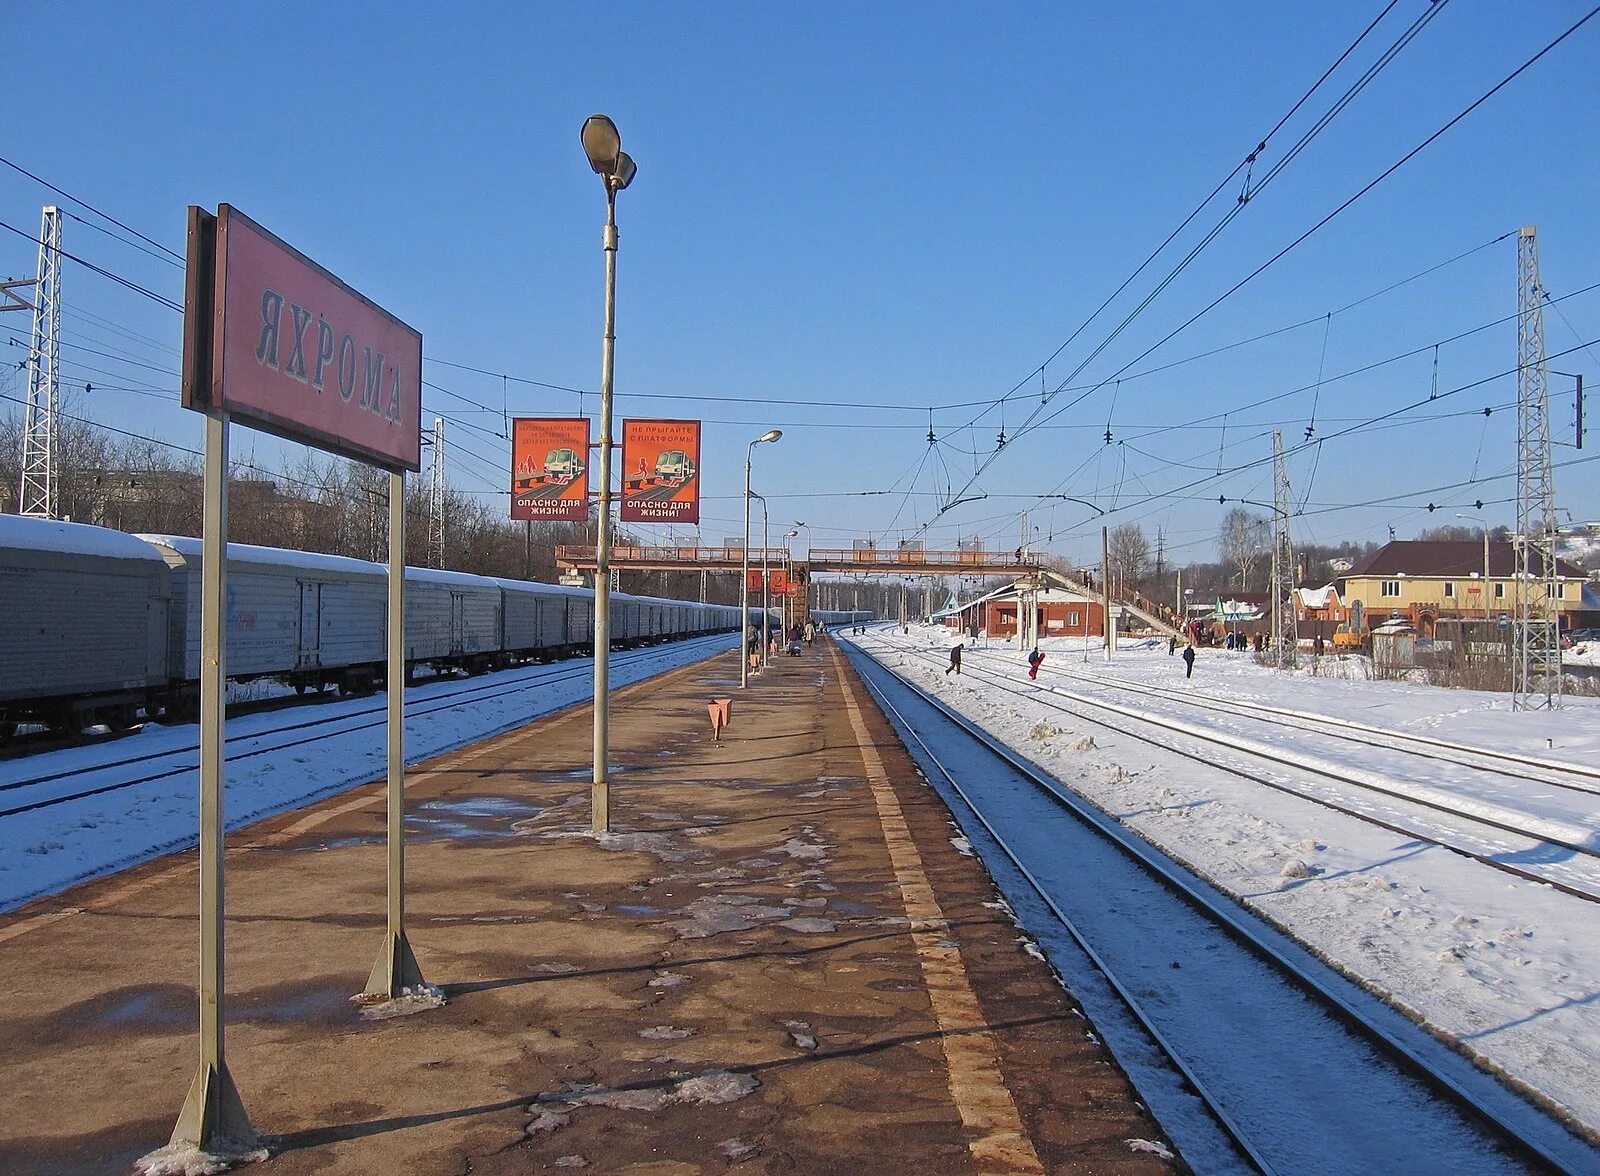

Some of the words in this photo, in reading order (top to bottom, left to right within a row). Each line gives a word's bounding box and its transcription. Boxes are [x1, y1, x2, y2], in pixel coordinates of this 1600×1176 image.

[255, 288, 402, 425] ЯХРОМА
[645, 426, 692, 434] ПРЫГАЙТЕ
[638, 435, 694, 443] ПЛАТФОРМЫ
[517, 499, 558, 507] ОПАСНО
[559, 499, 580, 508] ДЛЯ
[627, 500, 668, 509] ОПАСНО
[669, 501, 691, 510] ДЛЯ
[531, 507, 569, 515] ЖИЗНИ!
[640, 509, 679, 517] ЖИЗНИ!
